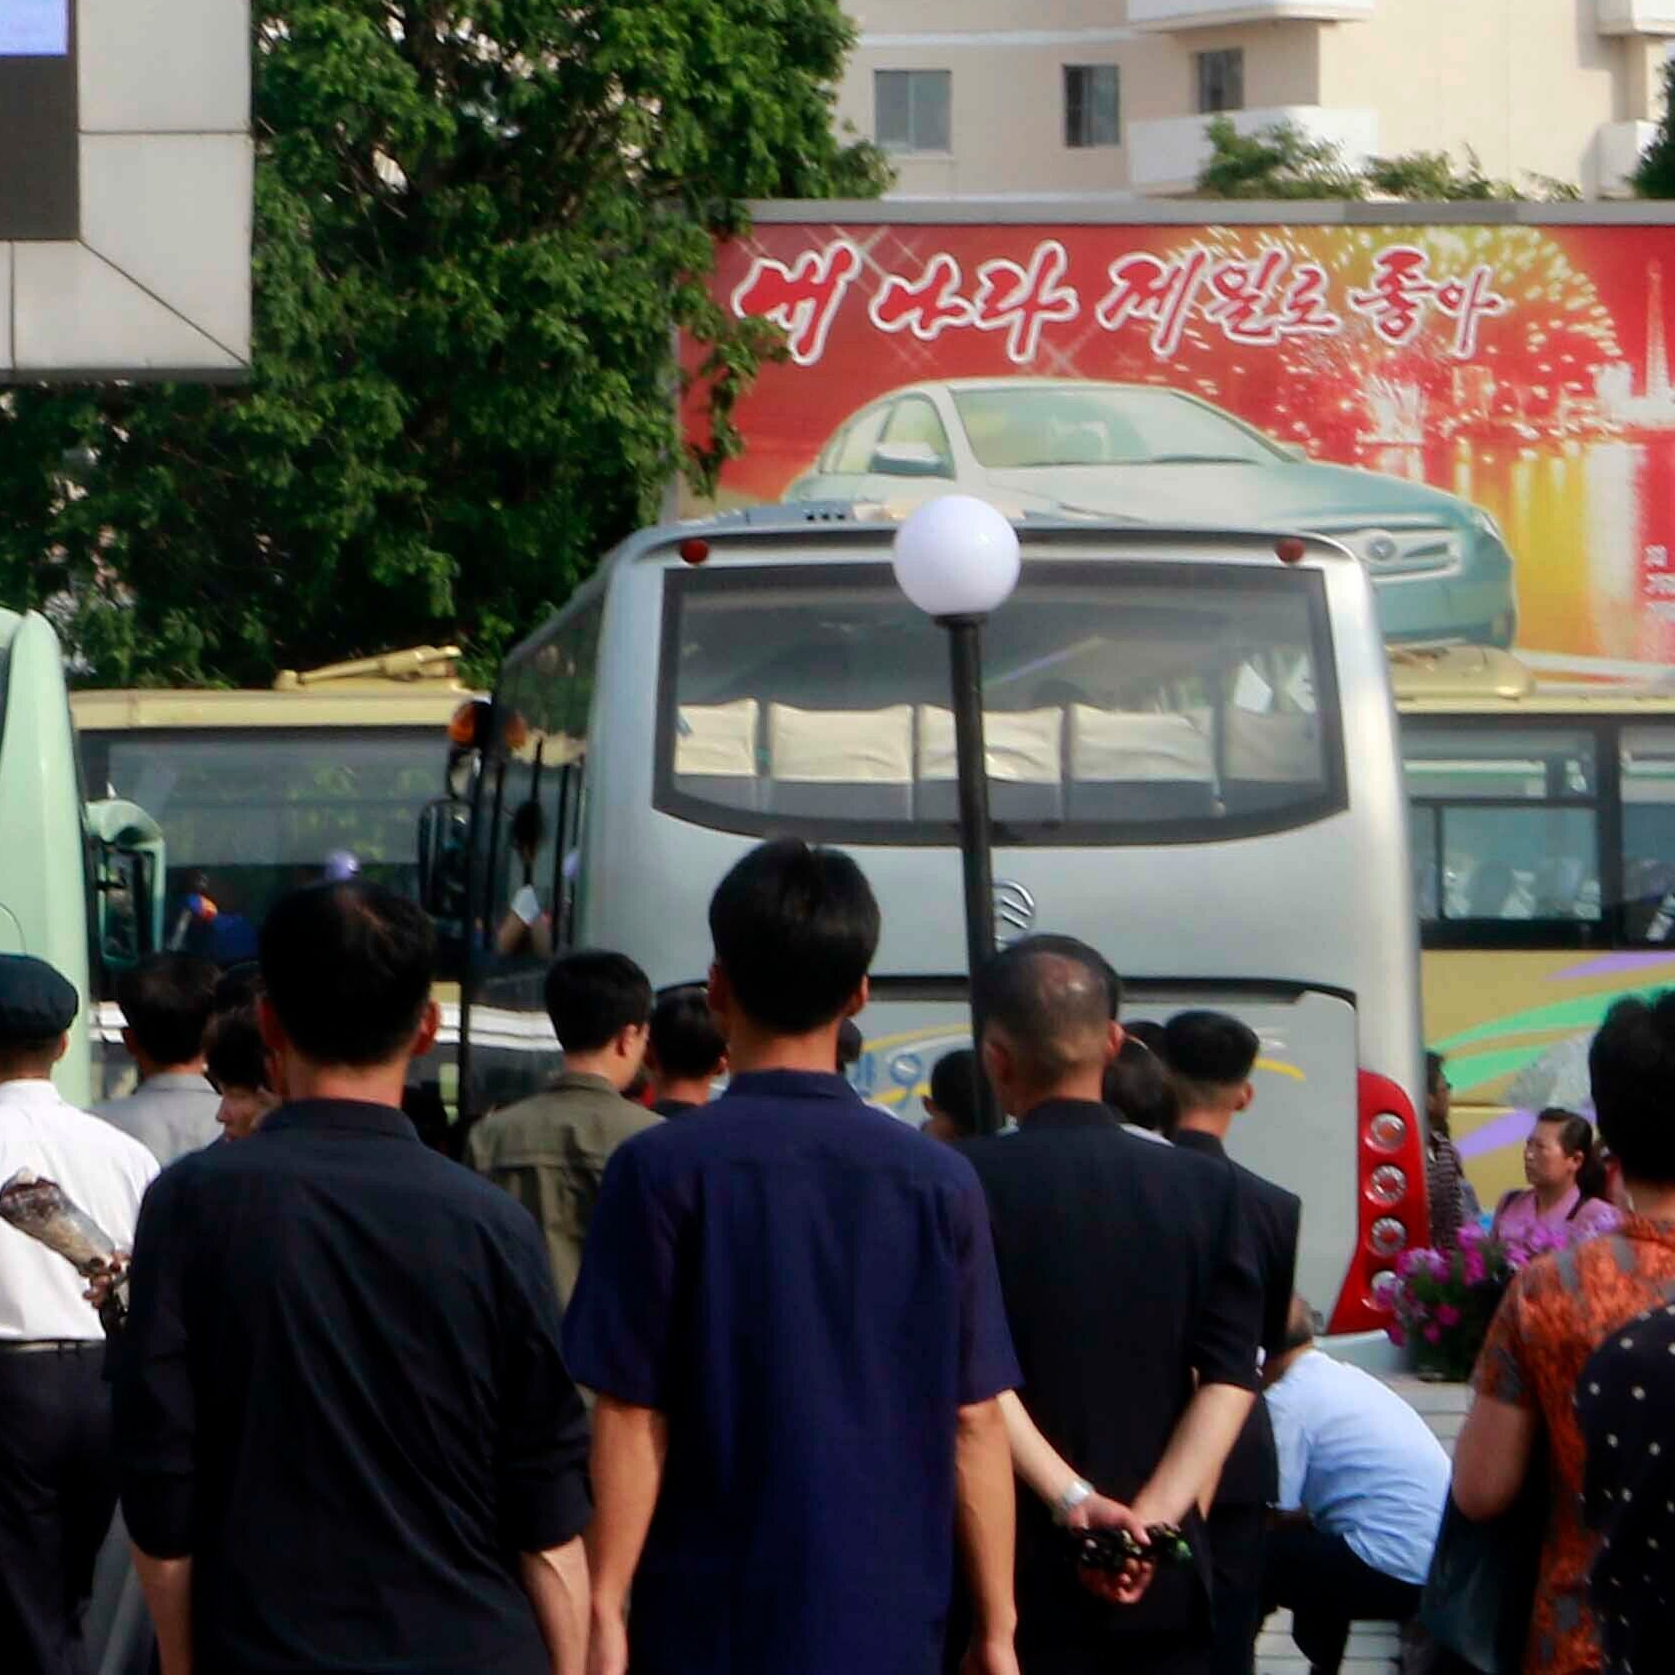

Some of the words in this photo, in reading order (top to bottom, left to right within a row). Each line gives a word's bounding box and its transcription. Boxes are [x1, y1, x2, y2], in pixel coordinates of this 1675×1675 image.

[732, 241, 861, 364] 내
[869, 240, 1079, 362] 나라
[1097, 247, 1342, 360] 제일로
[1349, 245, 1510, 359] 좋아
